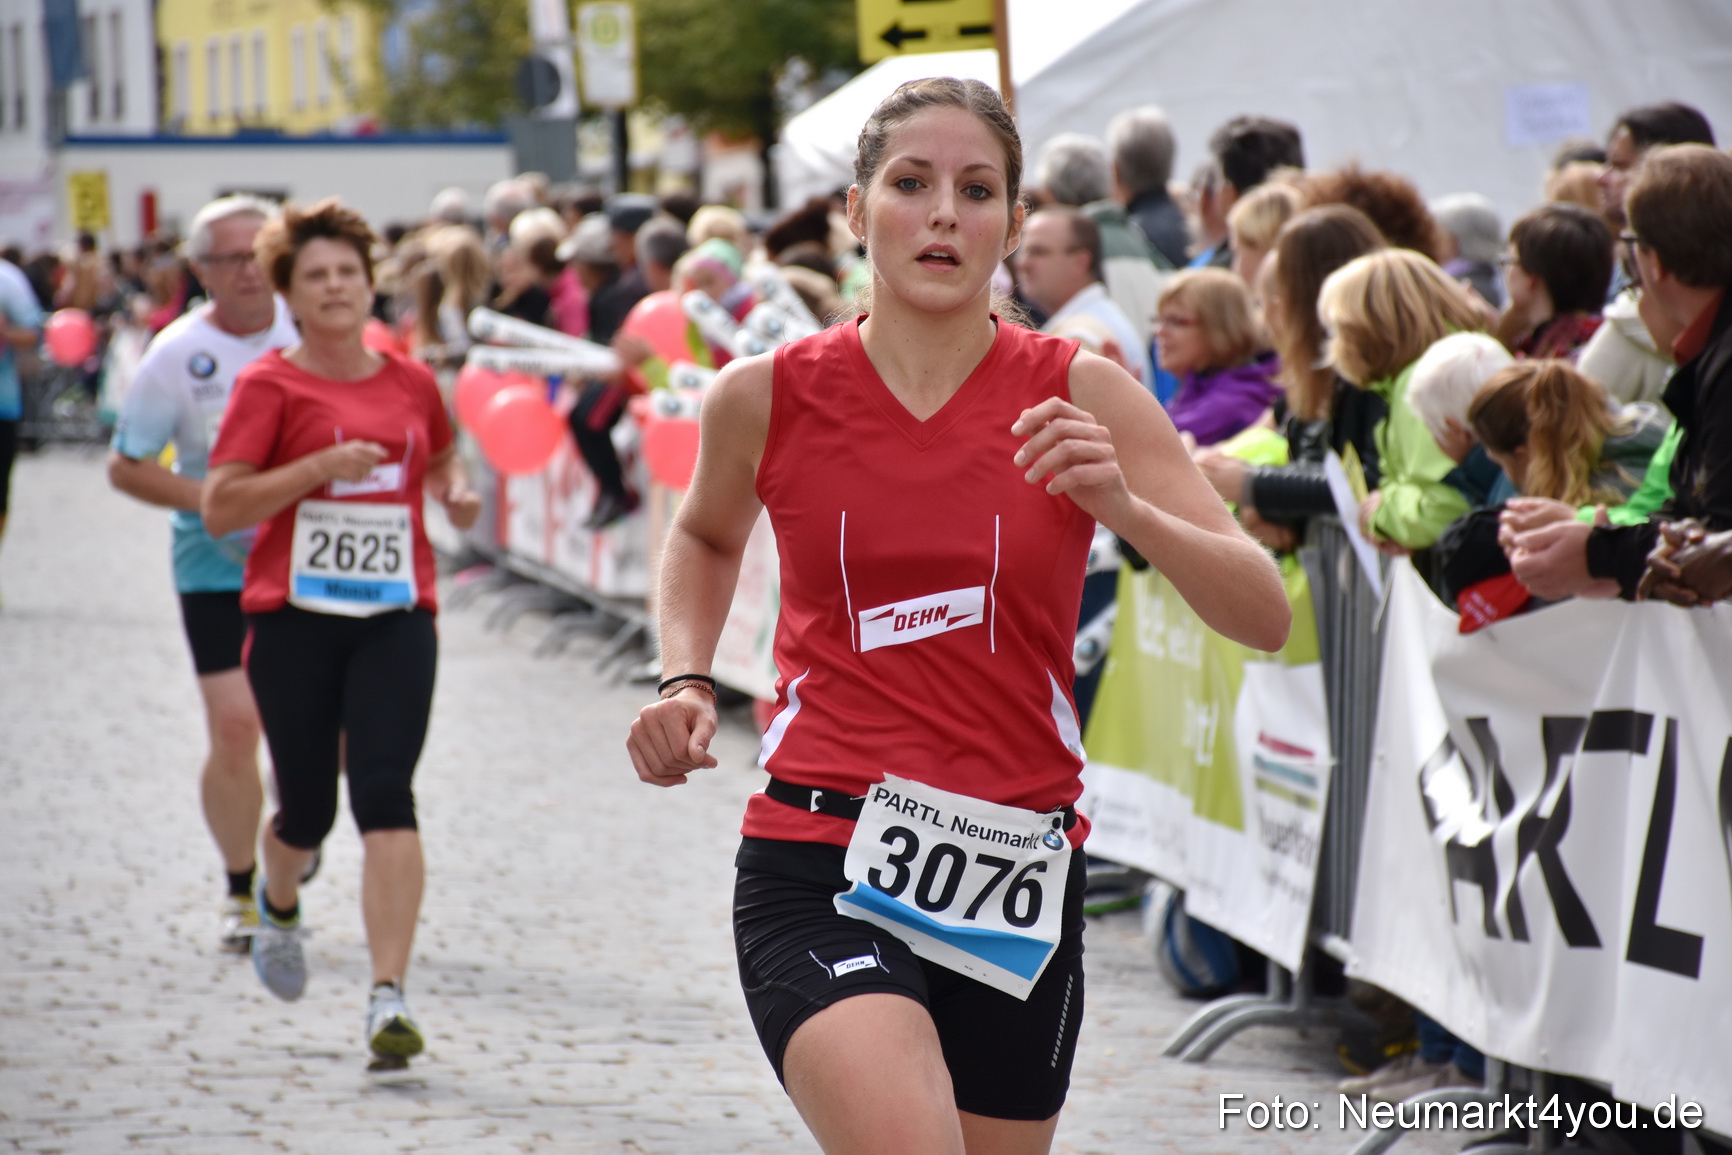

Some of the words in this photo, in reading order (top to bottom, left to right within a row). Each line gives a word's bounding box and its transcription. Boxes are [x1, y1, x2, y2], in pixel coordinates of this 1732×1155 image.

[308, 530, 401, 574] 2625
[893, 604, 950, 632] DEHN
[873, 787, 945, 828] PARTL
[951, 815, 1041, 851] Neumarkt
[867, 825, 1048, 928] 3076
[846, 960, 865, 969] DEHN
